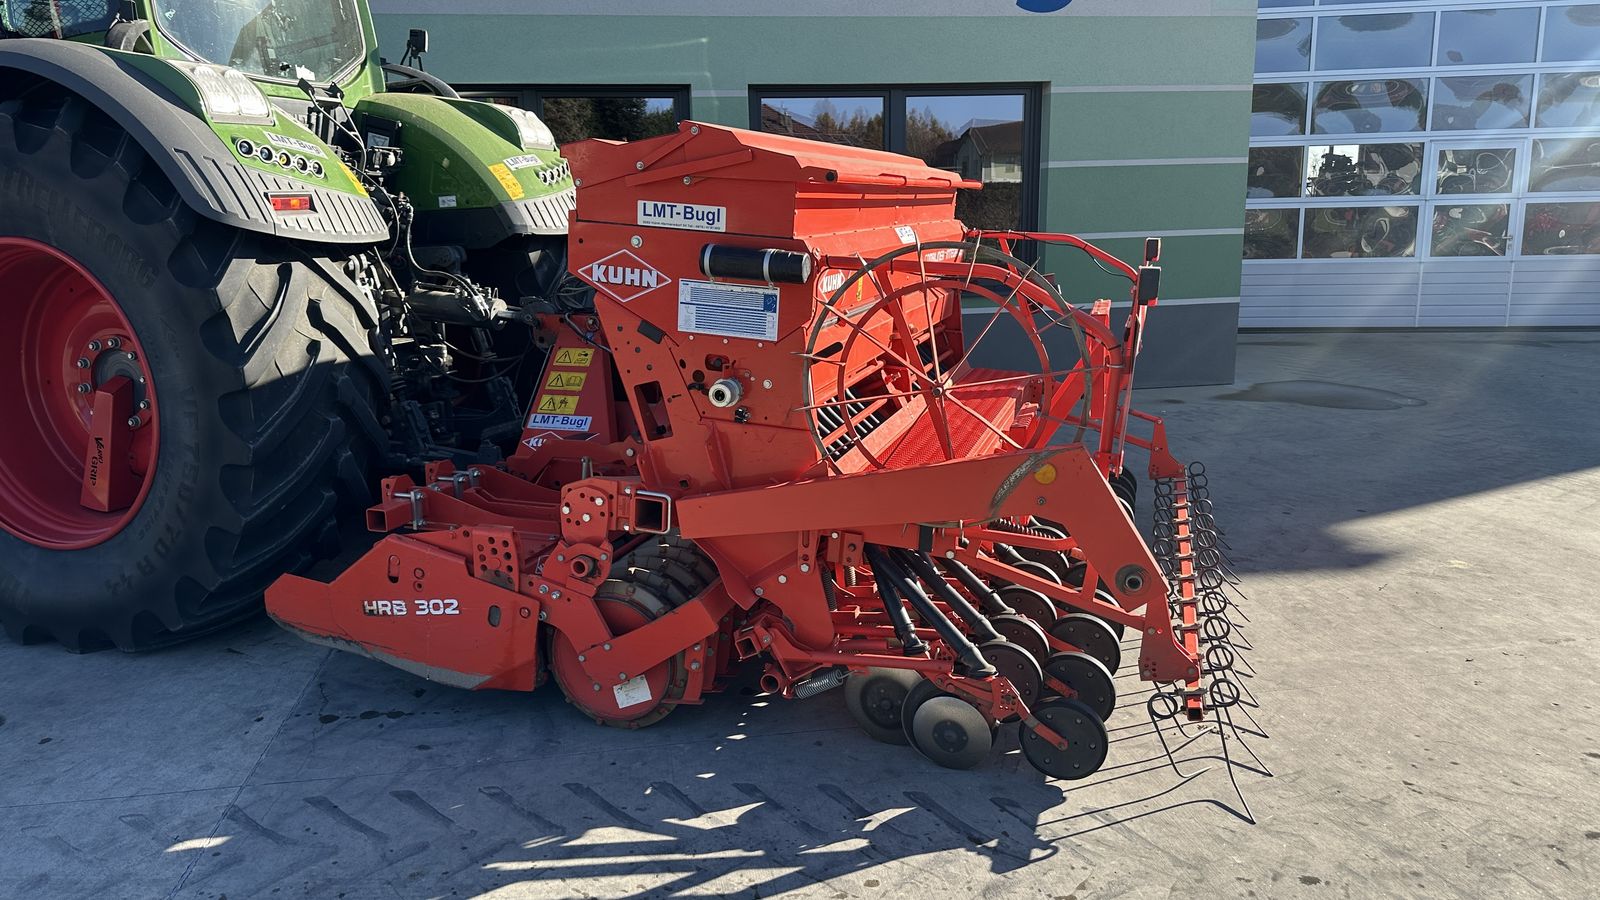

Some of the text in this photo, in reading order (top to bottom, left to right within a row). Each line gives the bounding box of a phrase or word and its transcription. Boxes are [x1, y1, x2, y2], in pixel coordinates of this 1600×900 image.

[642, 202, 721, 226] LMT-Bugl
[592, 263, 658, 288] KUHN
[822, 272, 843, 293] KUHN
[532, 414, 588, 428] LMT-Bugl
[90, 456, 98, 487] GRIP
[363, 598, 460, 616] HRB 302
